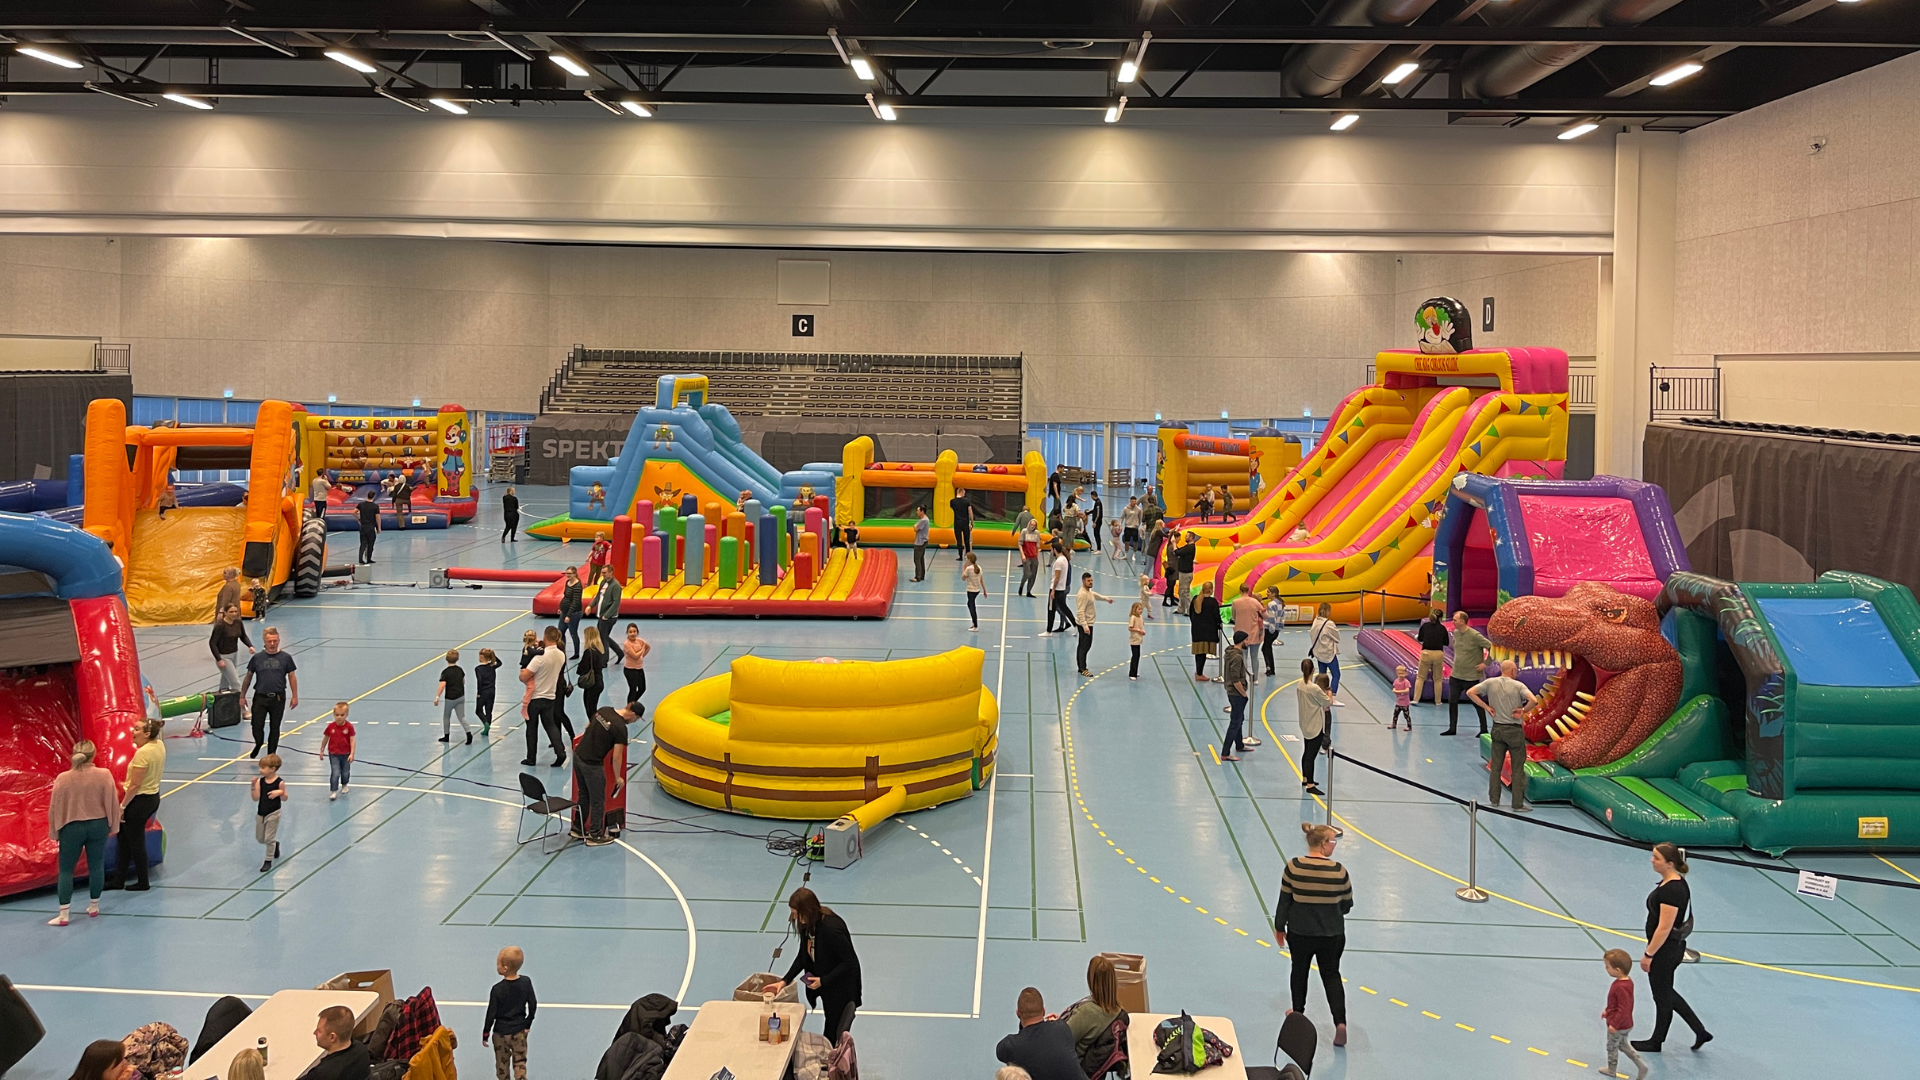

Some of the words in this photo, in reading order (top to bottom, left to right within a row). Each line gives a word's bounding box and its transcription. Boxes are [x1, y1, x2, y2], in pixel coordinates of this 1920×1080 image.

[1485, 304, 1491, 325] D
[798, 318, 808, 333] C
[318, 419, 369, 430] CIRCUS
[373, 419, 427, 430] BOUNCER
[1184, 438, 1216, 451] WESTERN
[1219, 441, 1241, 454] TOWN
